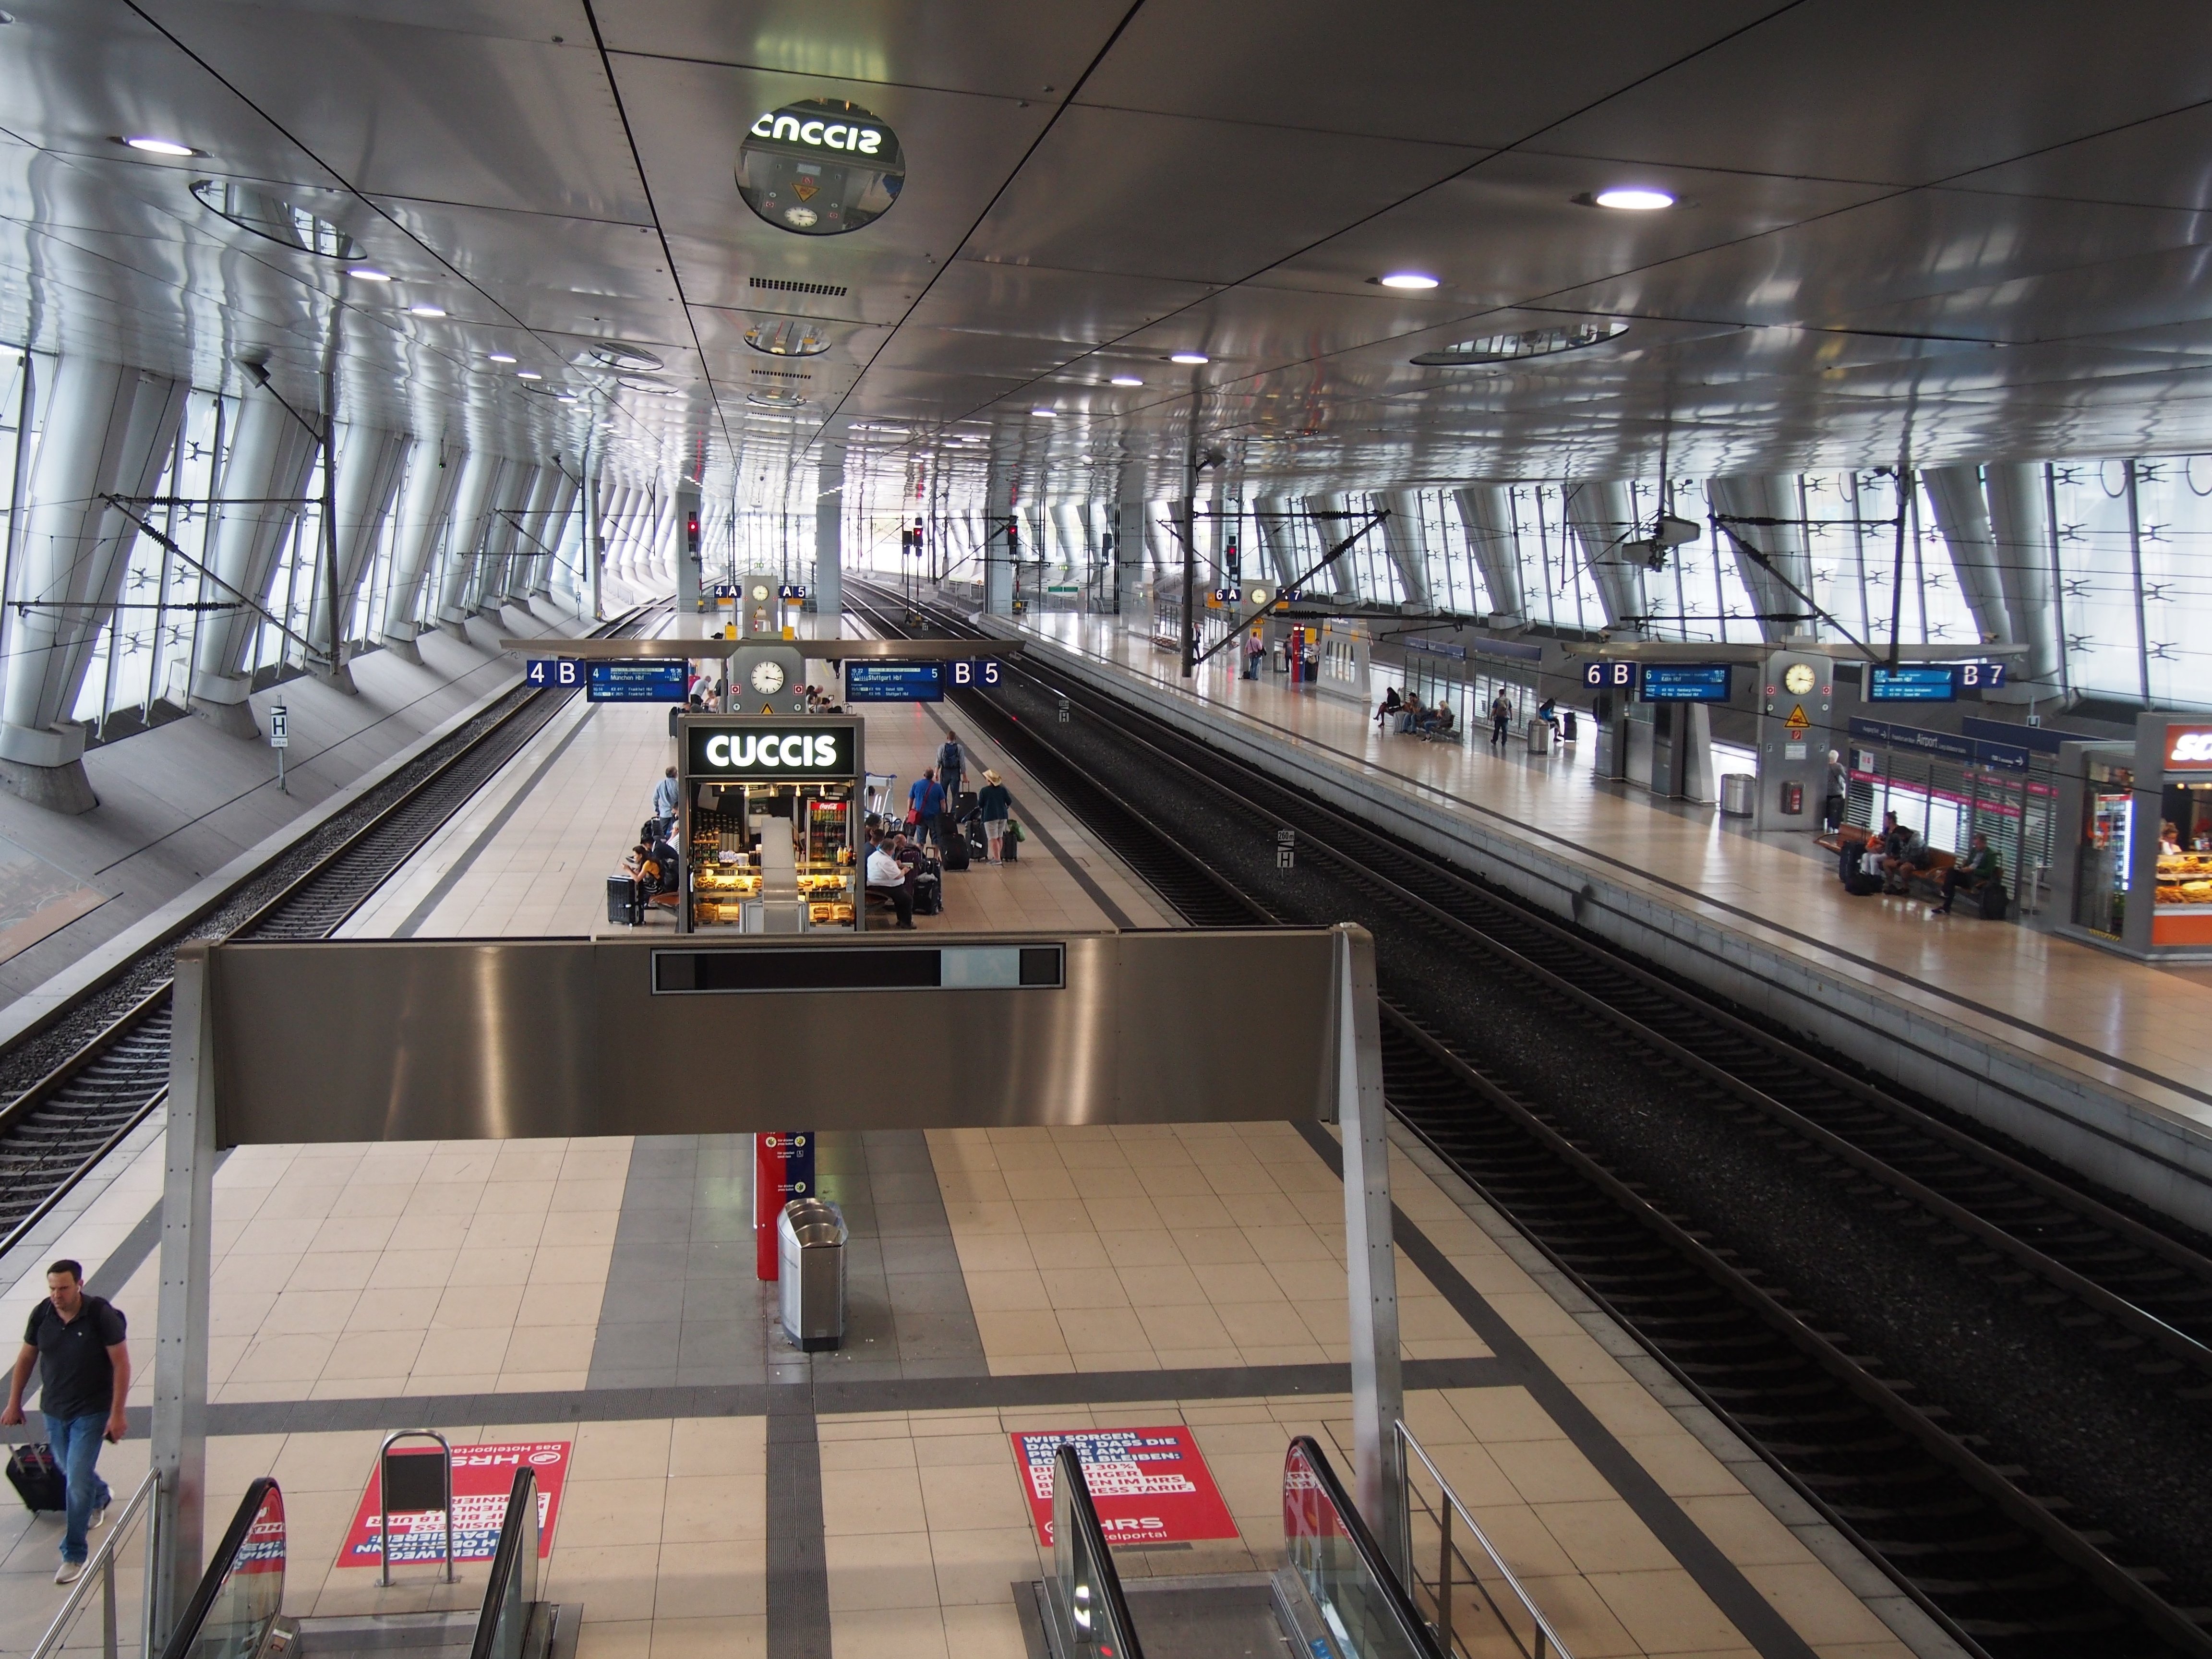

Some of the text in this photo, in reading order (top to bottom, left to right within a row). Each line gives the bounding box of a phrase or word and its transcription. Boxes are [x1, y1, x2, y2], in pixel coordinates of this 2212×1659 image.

[715, 586, 737, 597] 4 A
[783, 586, 805, 597] A 5
[1216, 589, 1237, 600] 6 A
[1294, 590, 1300, 600] 7
[530, 663, 575, 683] 4 B
[593, 668, 599, 678] 4
[932, 669, 938, 678] 5
[956, 663, 998, 683] B 5
[1588, 664, 1628, 684] 6 B
[1646, 670, 1651, 679] 6
[1964, 665, 2003, 685] B 7
[274, 717, 285, 734] H
[1916, 733, 1938, 748] Airport
[706, 735, 837, 767] CUCCIS
[1281, 853, 1290, 867] H
[1065, 1432, 1136, 1442] SORGEN
[1026, 1442, 1092, 1451] DAFR,
[1096, 1439, 1142, 1448] DASS
[451, 1454, 519, 1467] HRS
[1098, 1453, 1180, 1462] BLEIBEN:
[1133, 1484, 1192, 1492] TARIF.
[1105, 1531, 1167, 1540] telportal
[389, 1550, 437, 1560] WEG
